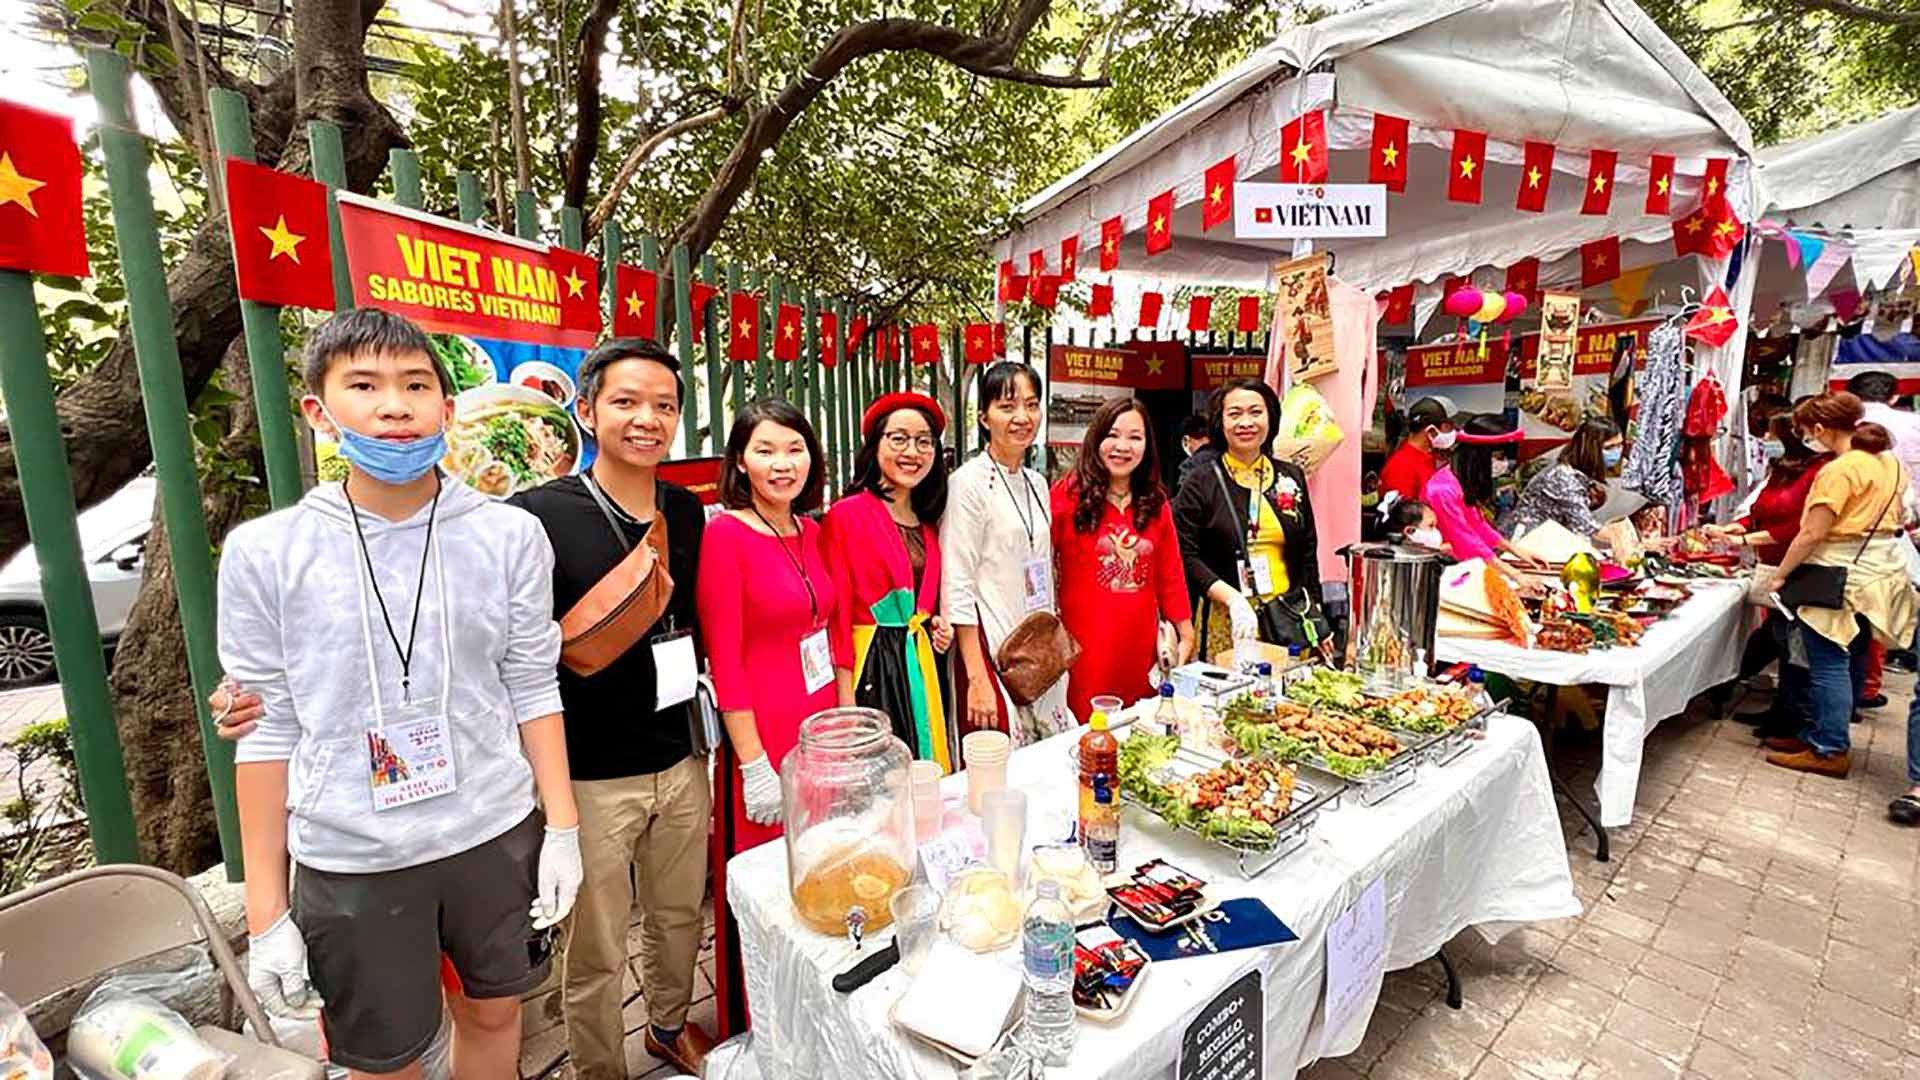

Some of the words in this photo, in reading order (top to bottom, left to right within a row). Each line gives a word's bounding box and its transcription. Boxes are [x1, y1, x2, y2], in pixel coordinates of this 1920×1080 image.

[1275, 203, 1372, 227] VIETNAM
[396, 233, 481, 289] VIET
[491, 255, 561, 305] NAM
[368, 274, 476, 313] SABORES
[1065, 352, 1092, 368] VIET
[1094, 355, 1124, 371] NAM
[1204, 361, 1230, 376] VIET
[1232, 361, 1260, 376] NAM
[1421, 350, 1451, 368] VIET
